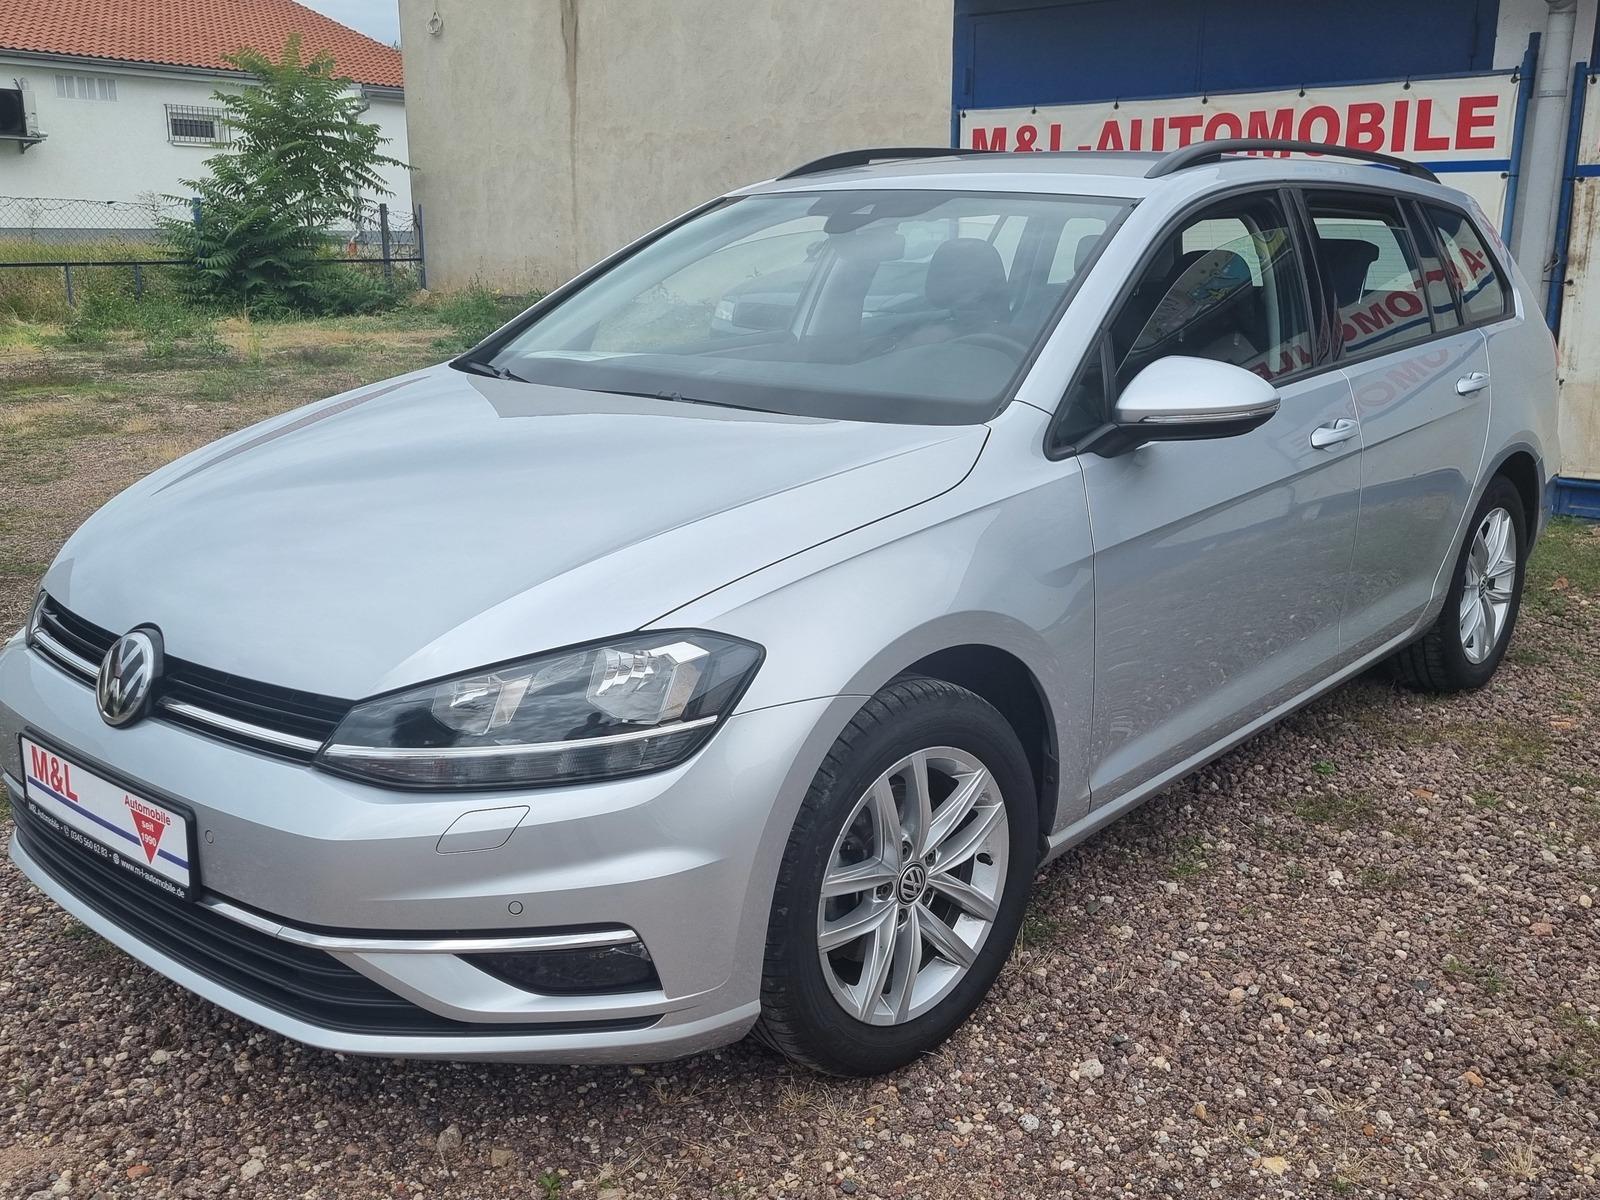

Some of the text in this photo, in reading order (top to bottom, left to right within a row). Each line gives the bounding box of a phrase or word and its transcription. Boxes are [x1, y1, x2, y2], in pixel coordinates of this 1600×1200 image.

[31, 745, 78, 803] M&L
[124, 794, 172, 827] Automobile
[141, 820, 154, 832] seit
[70, 830, 83, 845] 0345
[83, 837, 93, 850] 560
[141, 832, 156, 847] 1990
